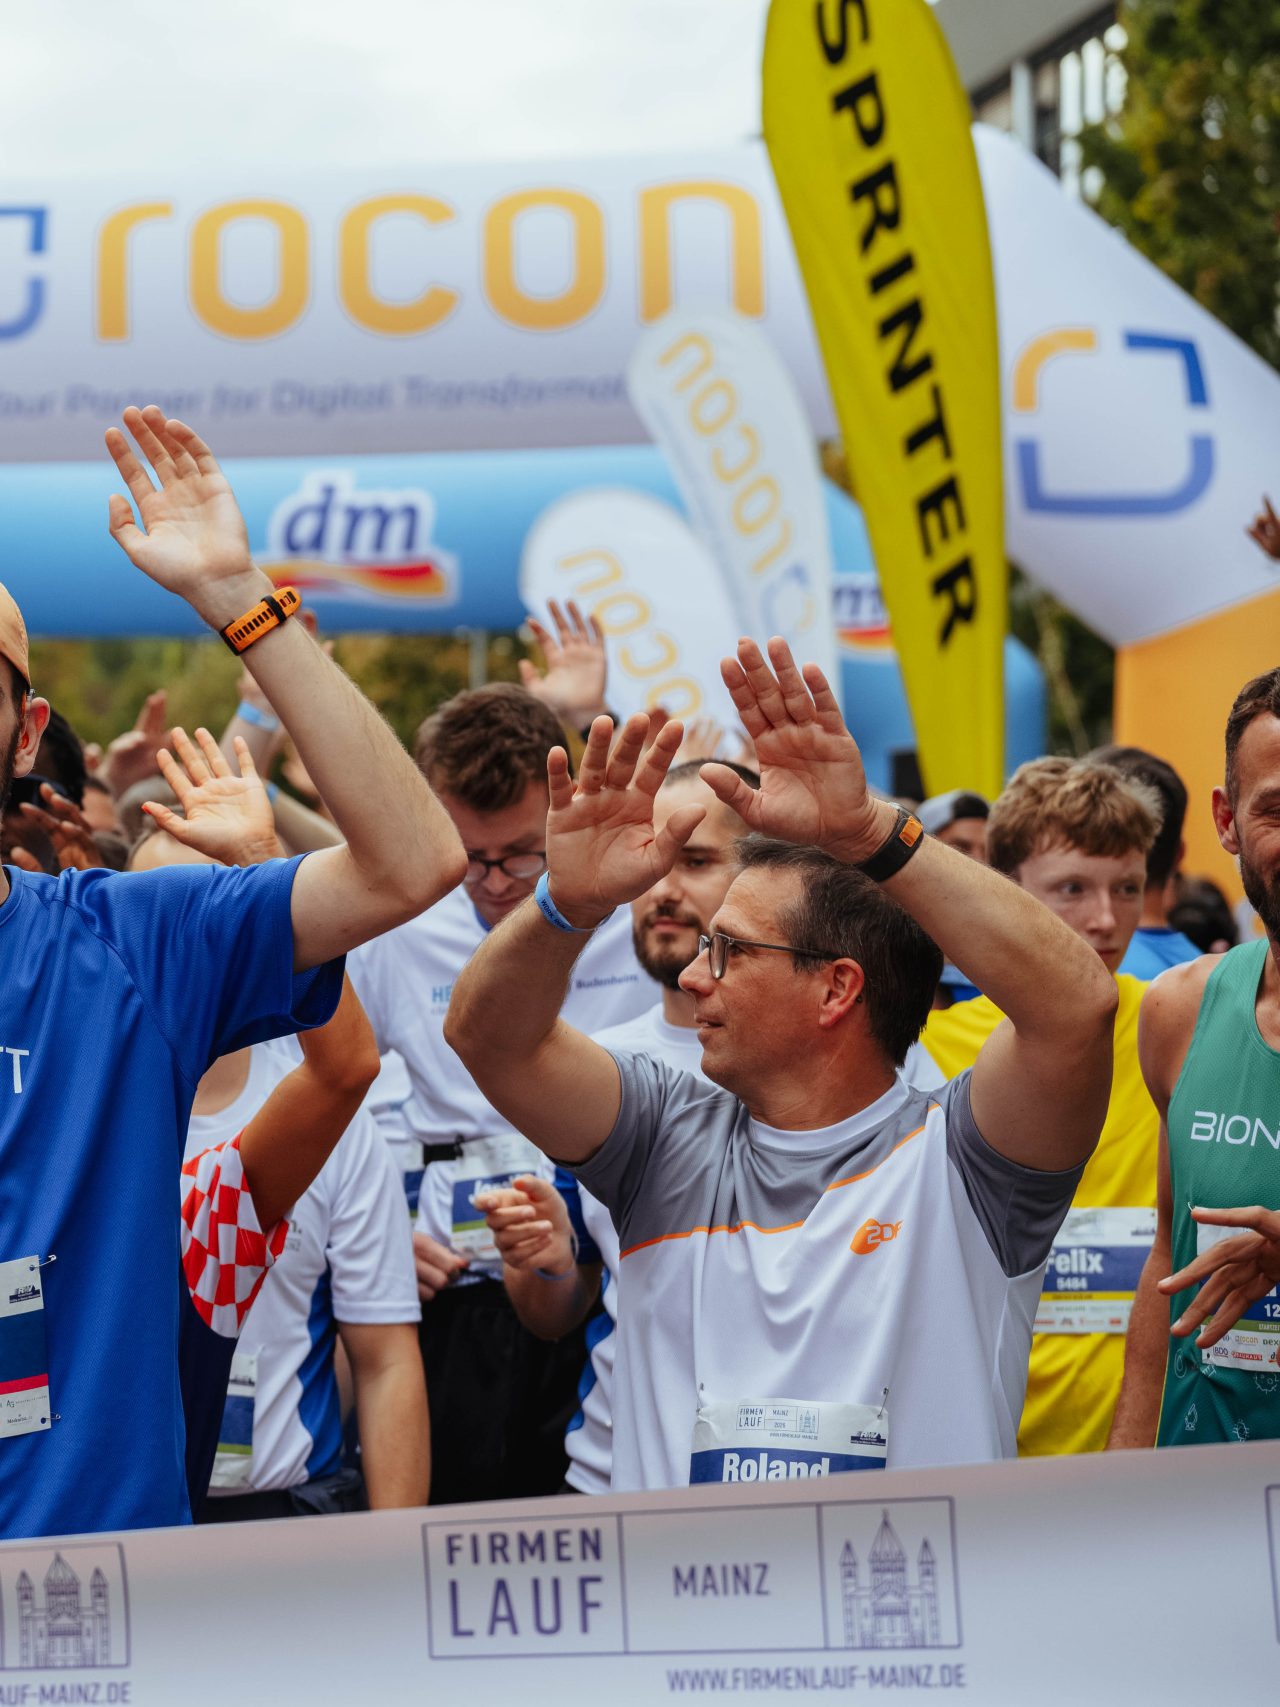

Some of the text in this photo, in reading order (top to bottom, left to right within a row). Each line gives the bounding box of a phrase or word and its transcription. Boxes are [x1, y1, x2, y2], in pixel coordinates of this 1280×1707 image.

[96, 181, 766, 342] rocon
[818, 0, 978, 650] SPRINTER
[282, 483, 422, 557] dm
[832, 586, 884, 616] m
[1191, 1110, 1280, 1150] BION
[738, 1416, 762, 1427] LAUF
[722, 1452, 830, 1483] Roland
[445, 1528, 604, 1566] FIRMEN
[673, 1563, 770, 1597] MAINZ
[448, 1575, 604, 1637] LAUF
[667, 1663, 967, 1692] WWW.FIRMENLAUF-MAINZ.DE
